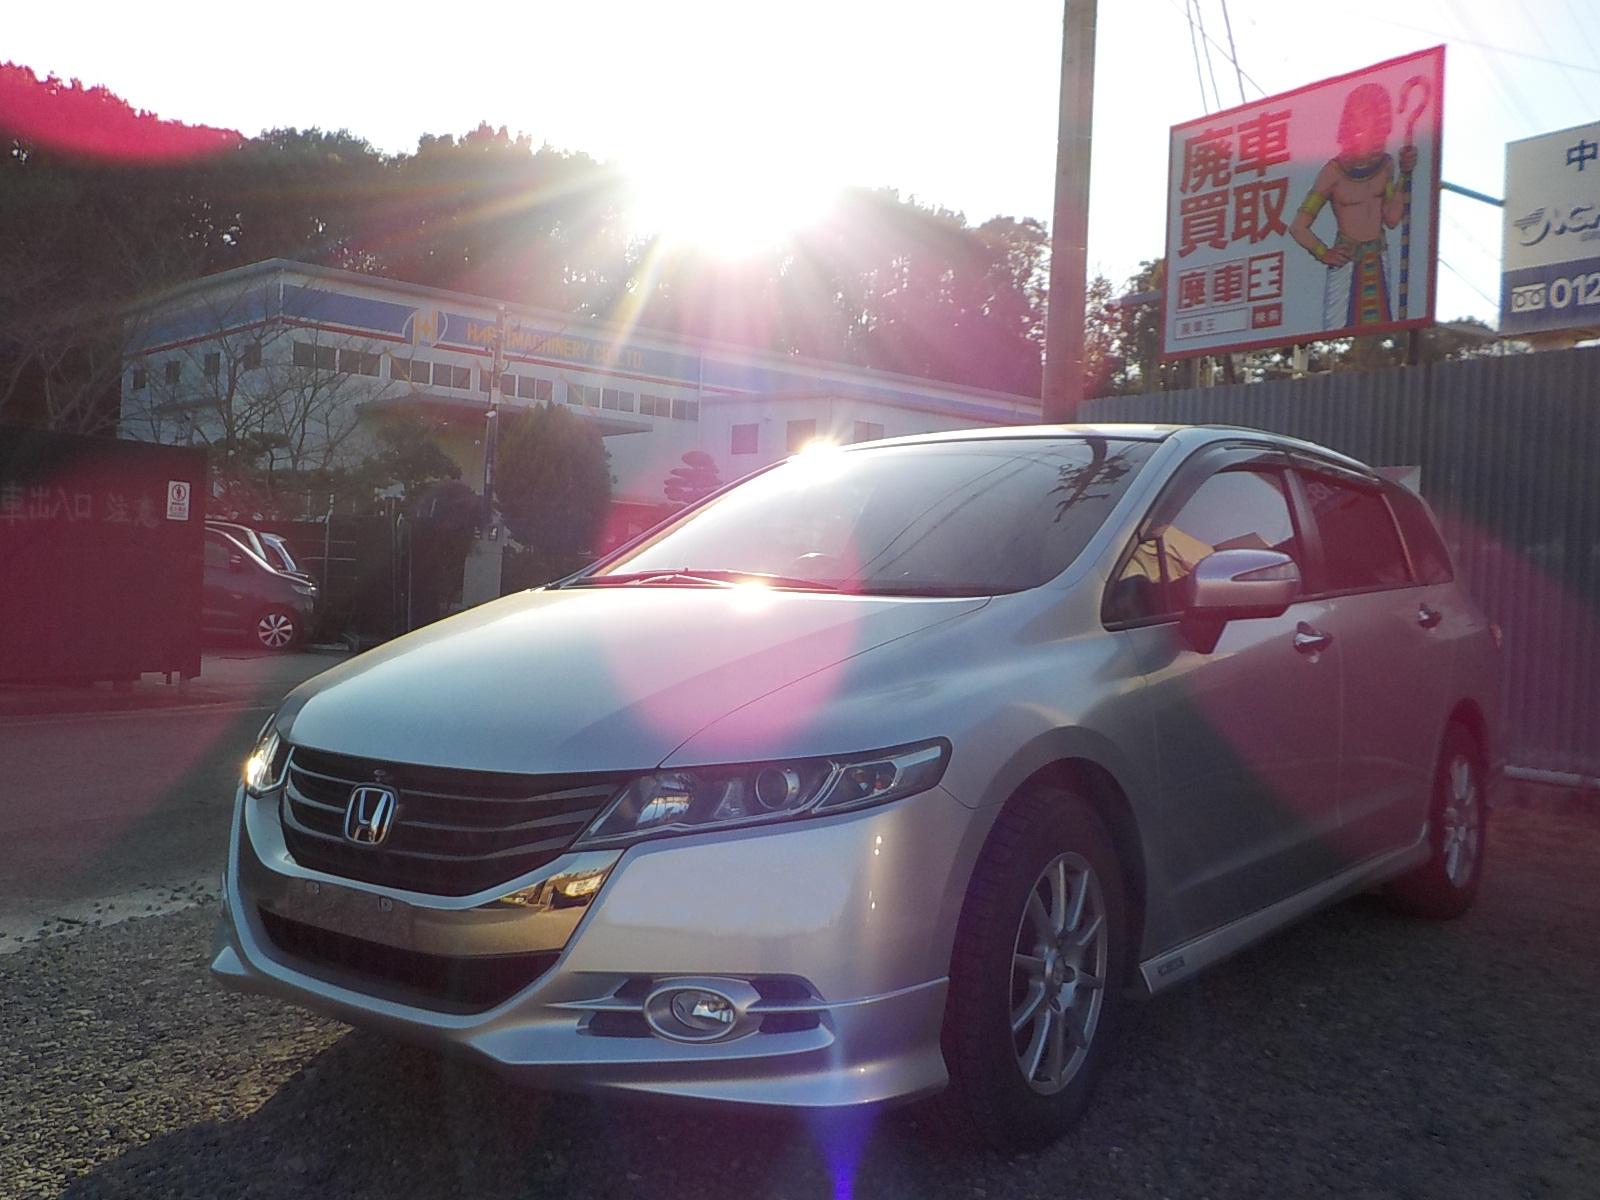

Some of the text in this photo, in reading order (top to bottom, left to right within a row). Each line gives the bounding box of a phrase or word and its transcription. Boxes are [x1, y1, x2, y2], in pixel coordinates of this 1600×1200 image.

[1179, 108, 1293, 193] 廃車
[1565, 139, 1599, 172] 中
[1178, 176, 1289, 258] 買取
